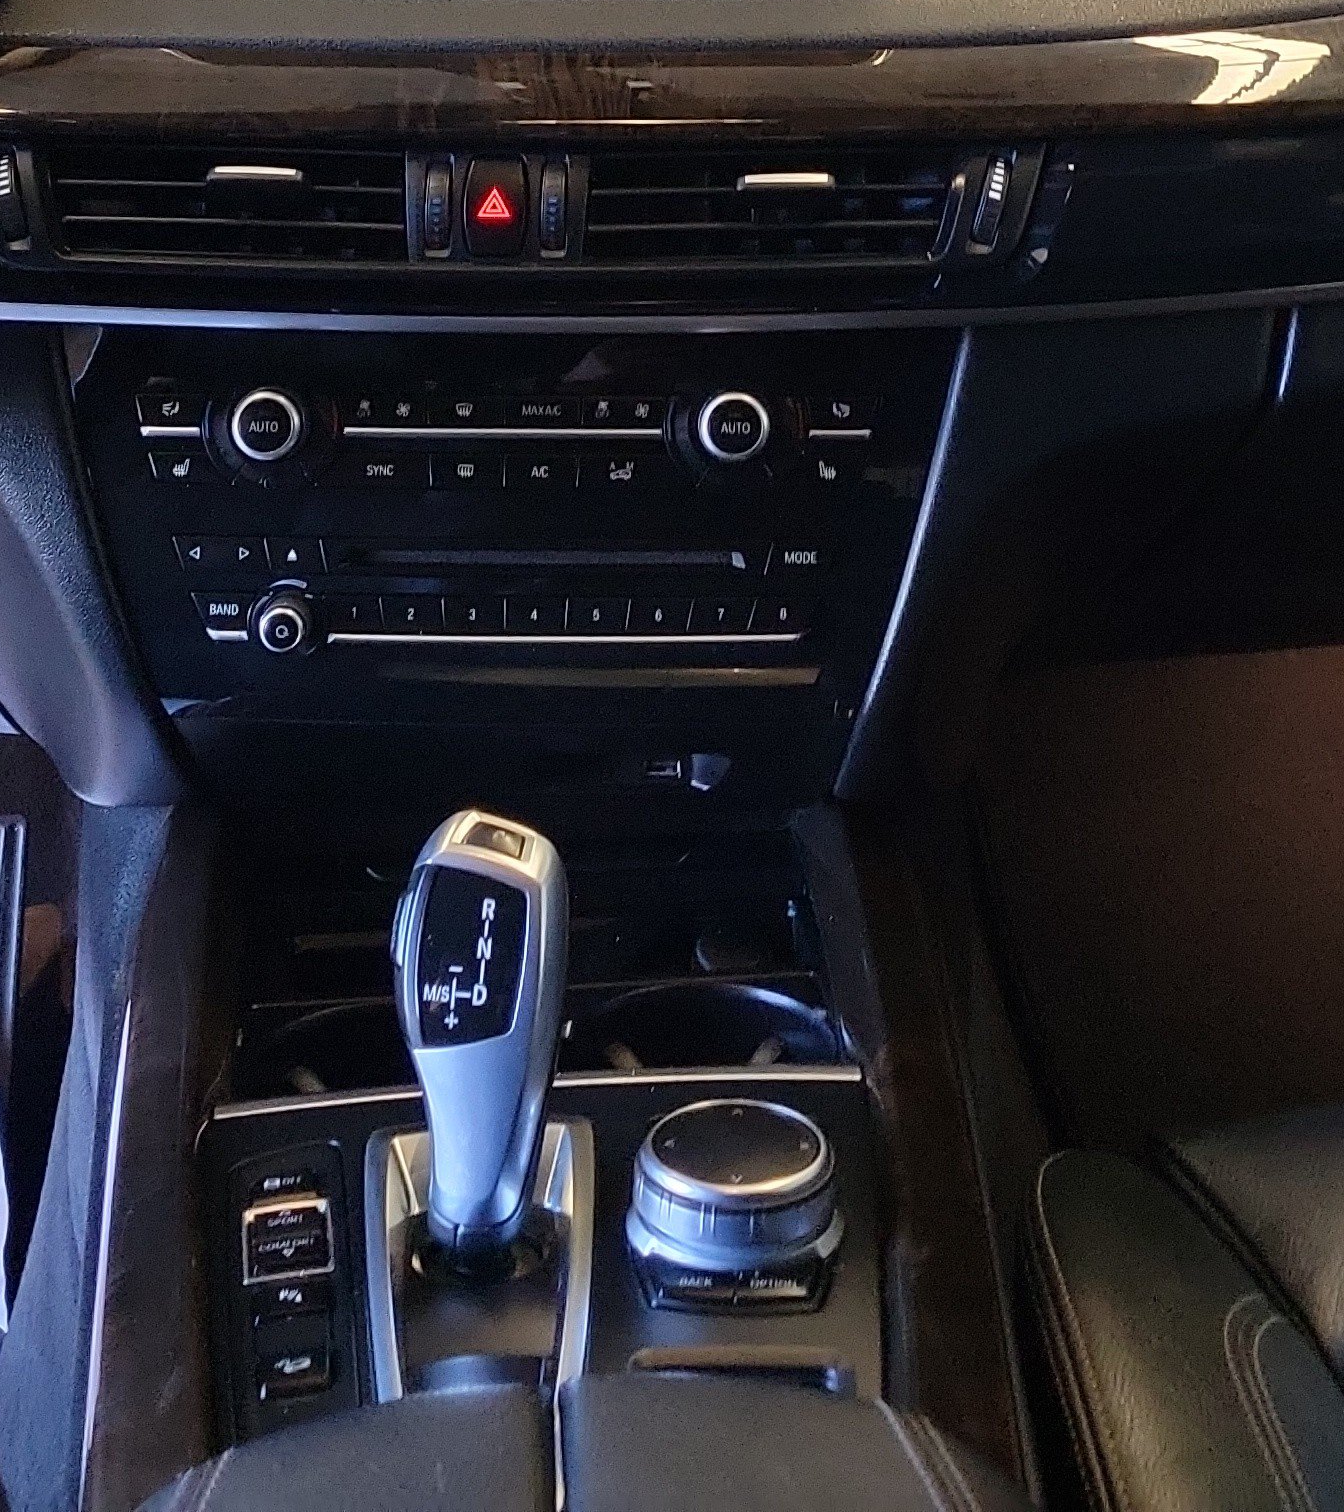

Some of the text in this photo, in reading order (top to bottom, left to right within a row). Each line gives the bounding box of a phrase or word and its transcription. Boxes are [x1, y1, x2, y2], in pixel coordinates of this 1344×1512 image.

[521, 404, 544, 416] MAX
[248, 420, 279, 434] AUTO
[720, 421, 751, 435] AUTO
[366, 464, 395, 477] SYNC
[530, 466, 549, 479] A/C
[784, 551, 818, 564] MODE
[209, 603, 239, 616] BAND
[351, 606, 357, 619] 1
[407, 607, 415, 620] 2
[468, 608, 477, 620] 3
[530, 608, 538, 621] 4
[718, 607, 725, 621] 7
[481, 897, 496, 921] R
[476, 936, 493, 960] N
[423, 982, 450, 1003] M/S
[472, 984, 487, 1006] D
